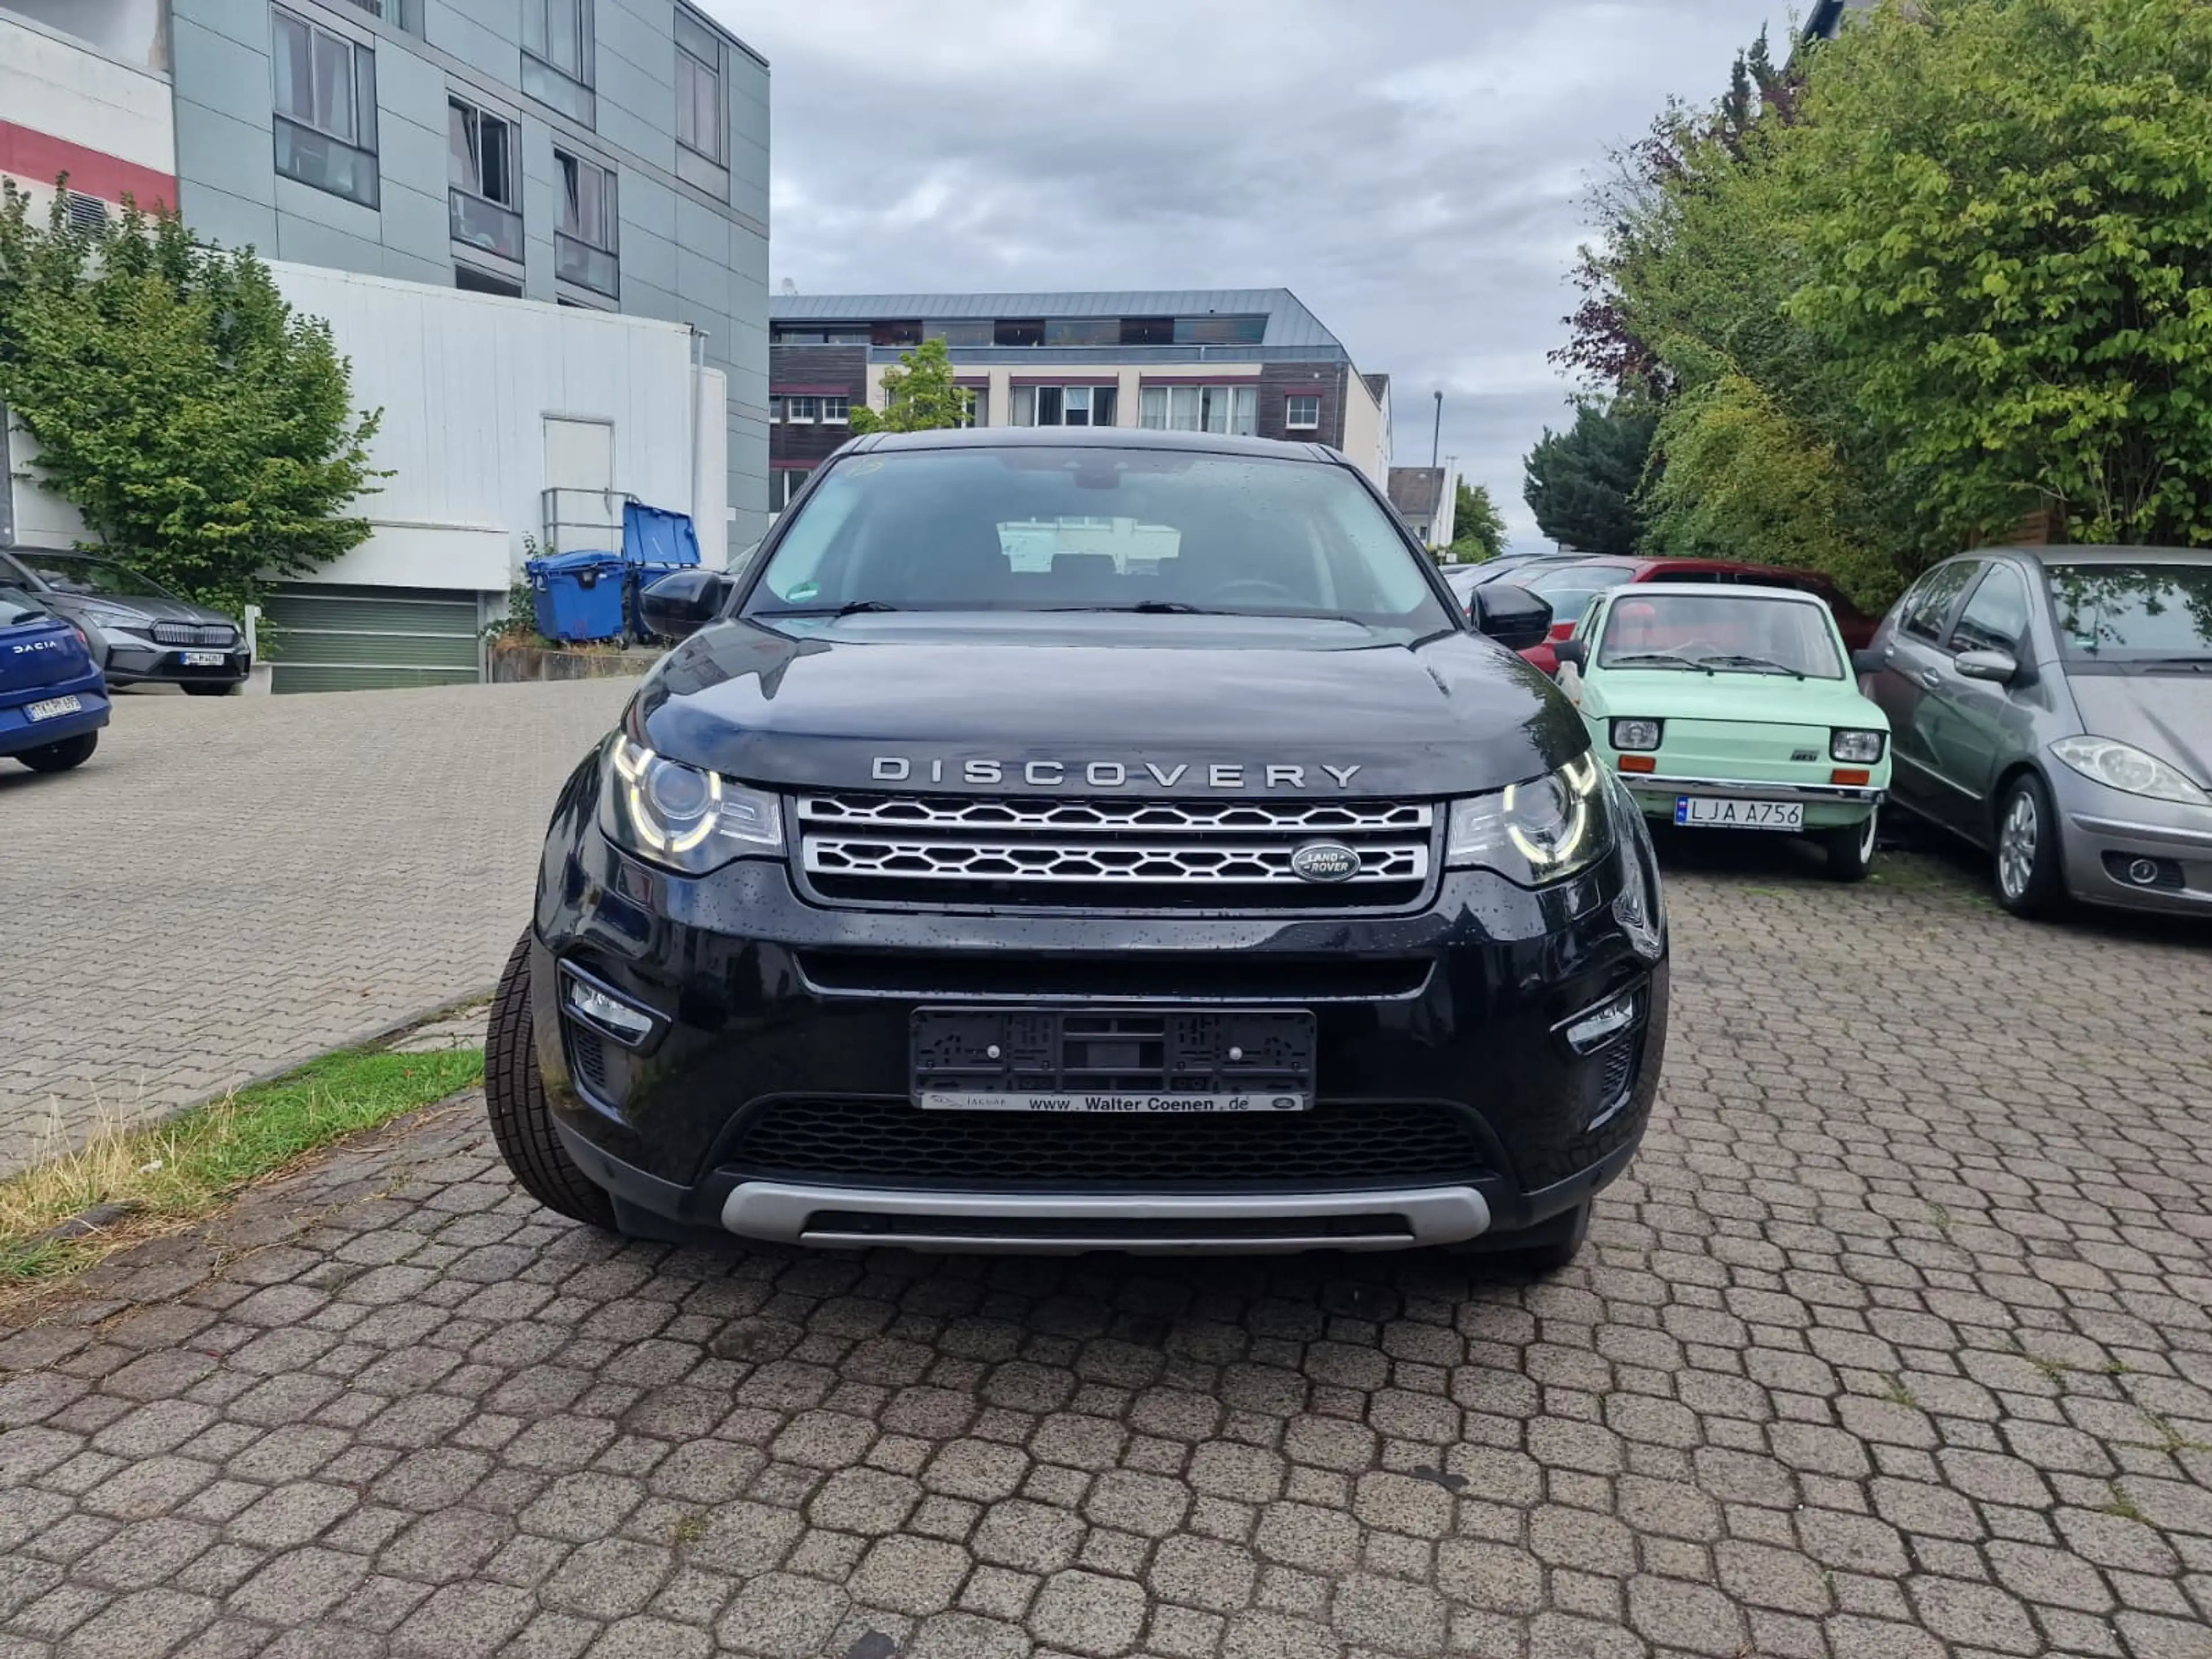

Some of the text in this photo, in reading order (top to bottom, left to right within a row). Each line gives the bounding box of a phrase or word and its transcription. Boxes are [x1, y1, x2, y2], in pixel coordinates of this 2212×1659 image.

[872, 756, 1362, 789] DISCOVERY
[1692, 801, 1800, 824] LJA A756
[1308, 853, 1338, 862] LAND
[1311, 862, 1349, 873] ROVER
